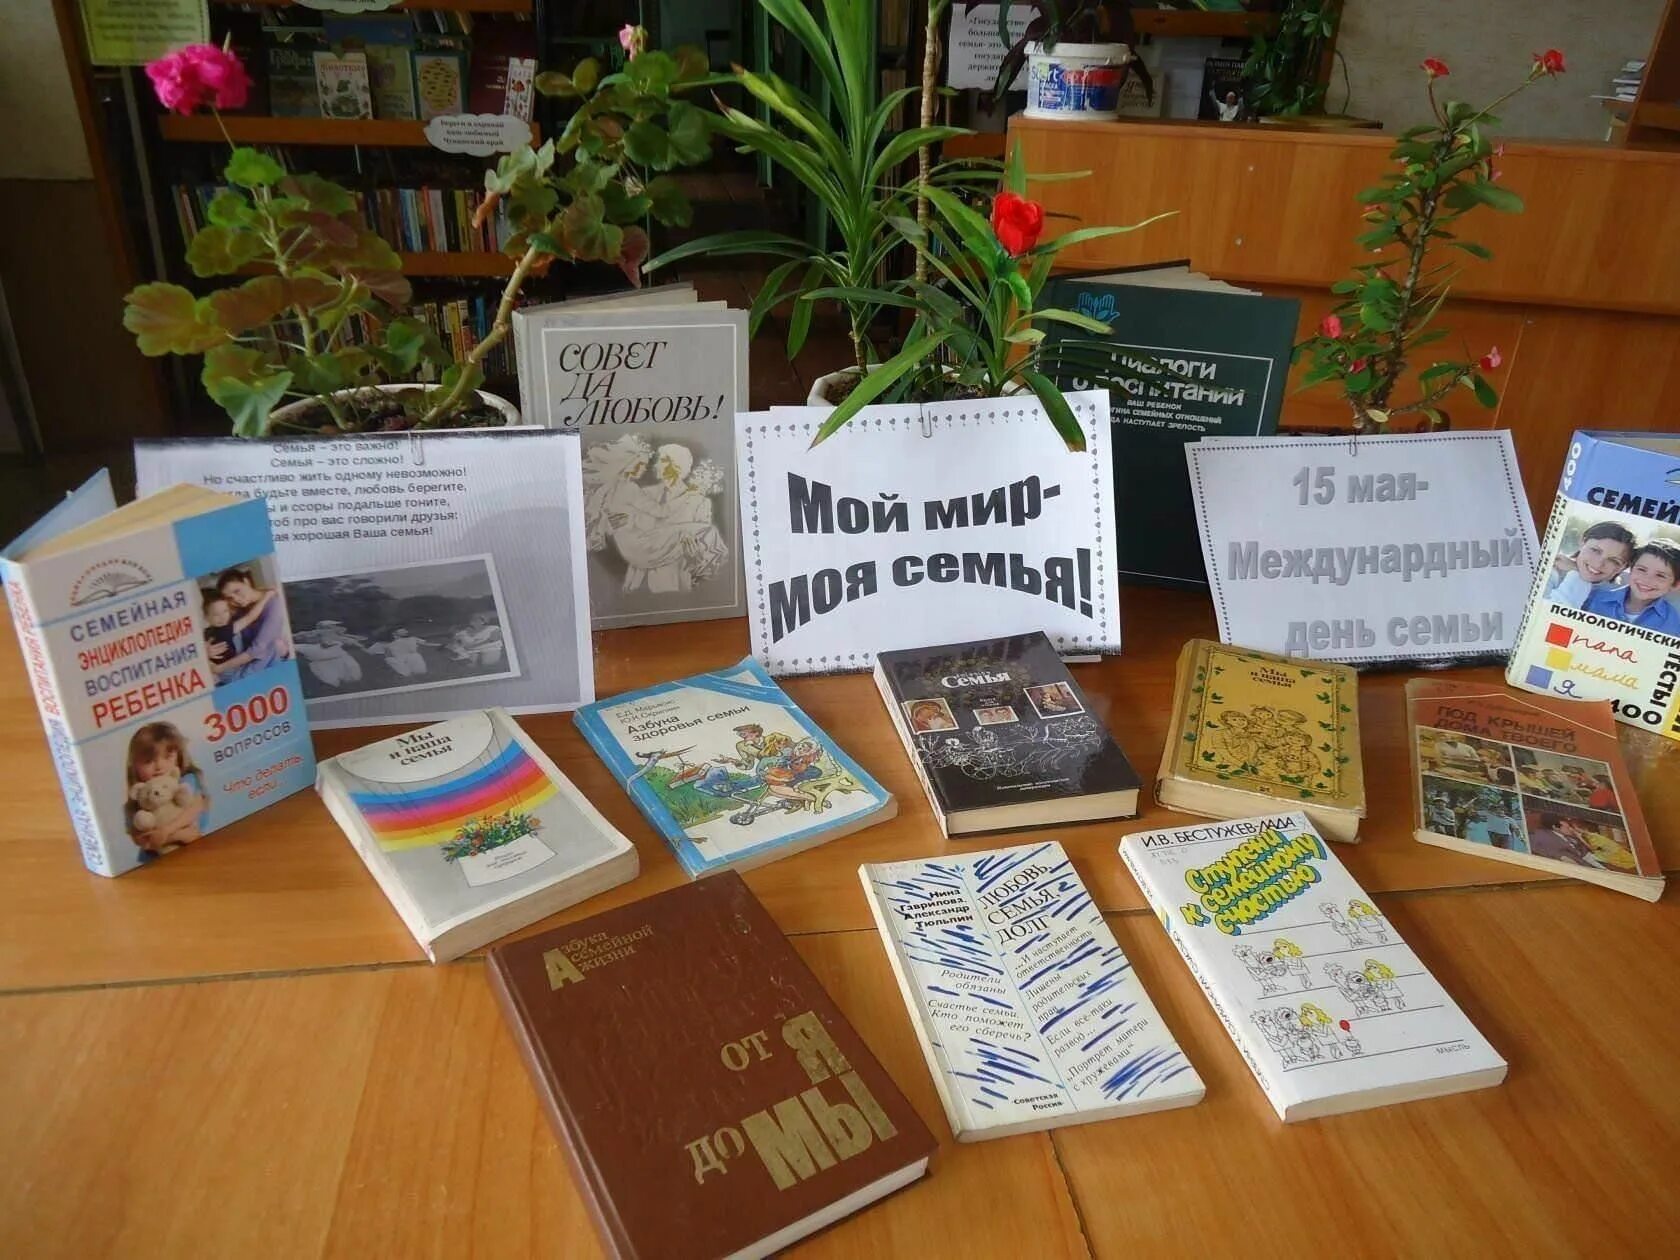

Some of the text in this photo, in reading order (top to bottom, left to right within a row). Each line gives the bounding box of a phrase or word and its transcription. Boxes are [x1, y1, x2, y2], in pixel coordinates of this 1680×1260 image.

[559, 341, 668, 372] СОВЕТ
[560, 371, 617, 404] ДА
[563, 394, 725, 427] ЛЮБОВЬ!
[1123, 417, 1165, 429] НАСТУПАЕТ
[1167, 423, 1206, 432] ЗРЕЛОСТЬ
[1133, 409, 1174, 419] СЕМЕЙНЫХ
[1175, 413, 1222, 425] ОТНОШЕНИЙ
[271, 455, 404, 467] Семья это сложно!
[273, 443, 315, 454] Семья
[331, 443, 351, 451] это
[203, 467, 467, 484] Но счастливо жить одному невозможно!
[302, 486, 351, 497] вместе,
[354, 484, 405, 495] любовь
[407, 482, 467, 494] берегите,
[1292, 466, 1429, 506] 15 мая-
[291, 502, 333, 513] ссоры
[338, 499, 401, 511] подальше
[788, 471, 1061, 534] Мой мир-
[1587, 486, 1680, 526] СЕМЕЙ
[292, 530, 350, 542] хорошая
[353, 529, 387, 539] Ваша
[391, 526, 433, 537] семья!
[294, 517, 318, 527] про
[321, 516, 344, 525] вас
[348, 513, 407, 525] говорили
[1227, 528, 1525, 586] Междунардный
[892, 547, 1094, 620] семья!
[70, 591, 188, 642] СЕМЕЙНАЯ
[78, 616, 194, 671] ЭНЦИКЛОПЕДИЯ
[1285, 618, 1376, 657] день
[1386, 611, 1504, 647] семьи
[1572, 635, 1638, 664] папа
[84, 643, 199, 697] ВОСПИТАНИЯ
[941, 672, 1012, 688] Семья
[1650, 652, 1680, 708] ТЕСТЫ
[92, 668, 206, 728] РЕБЕНКА
[203, 686, 288, 743] 3000
[627, 715, 681, 735] Азбука
[632, 704, 751, 742] здоровья семьи
[1438, 705, 1477, 723] ПОД
[1487, 715, 1577, 742] КРЫШЕЙ
[213, 721, 291, 763] ВОПРОСОВ
[389, 736, 452, 760] и наша
[396, 731, 434, 747] Мы
[1434, 718, 1578, 753] ДОМА ТВОЕГО
[400, 745, 452, 766] семья
[1141, 816, 1297, 849] И.В. БЕСТУЖЕВ-ЛАДА
[929, 889, 961, 899] Нина
[987, 889, 1061, 925] СЕМЬЯ,
[903, 905, 970, 920] Александр
[914, 915, 974, 928] Тюльпин
[995, 914, 1050, 944] ДОЛГ
[1031, 926, 1078, 958] наступает
[1016, 930, 1093, 979] ответственность
[941, 969, 1002, 984] Родители
[955, 982, 1007, 995] обязаны
[1025, 973, 1062, 1000] Лишены
[1032, 970, 1093, 1013] родительских
[928, 999, 978, 1012] Счастье
[931, 1009, 1024, 1030] Кто поможет
[949, 1023, 1032, 1042] его сберечь?
[1046, 999, 1113, 1045] Если все-таки
[1116, 1018, 1149, 1045] матери
[781, 1010, 853, 1085] Я
[739, 1069, 898, 1192] МЫ
